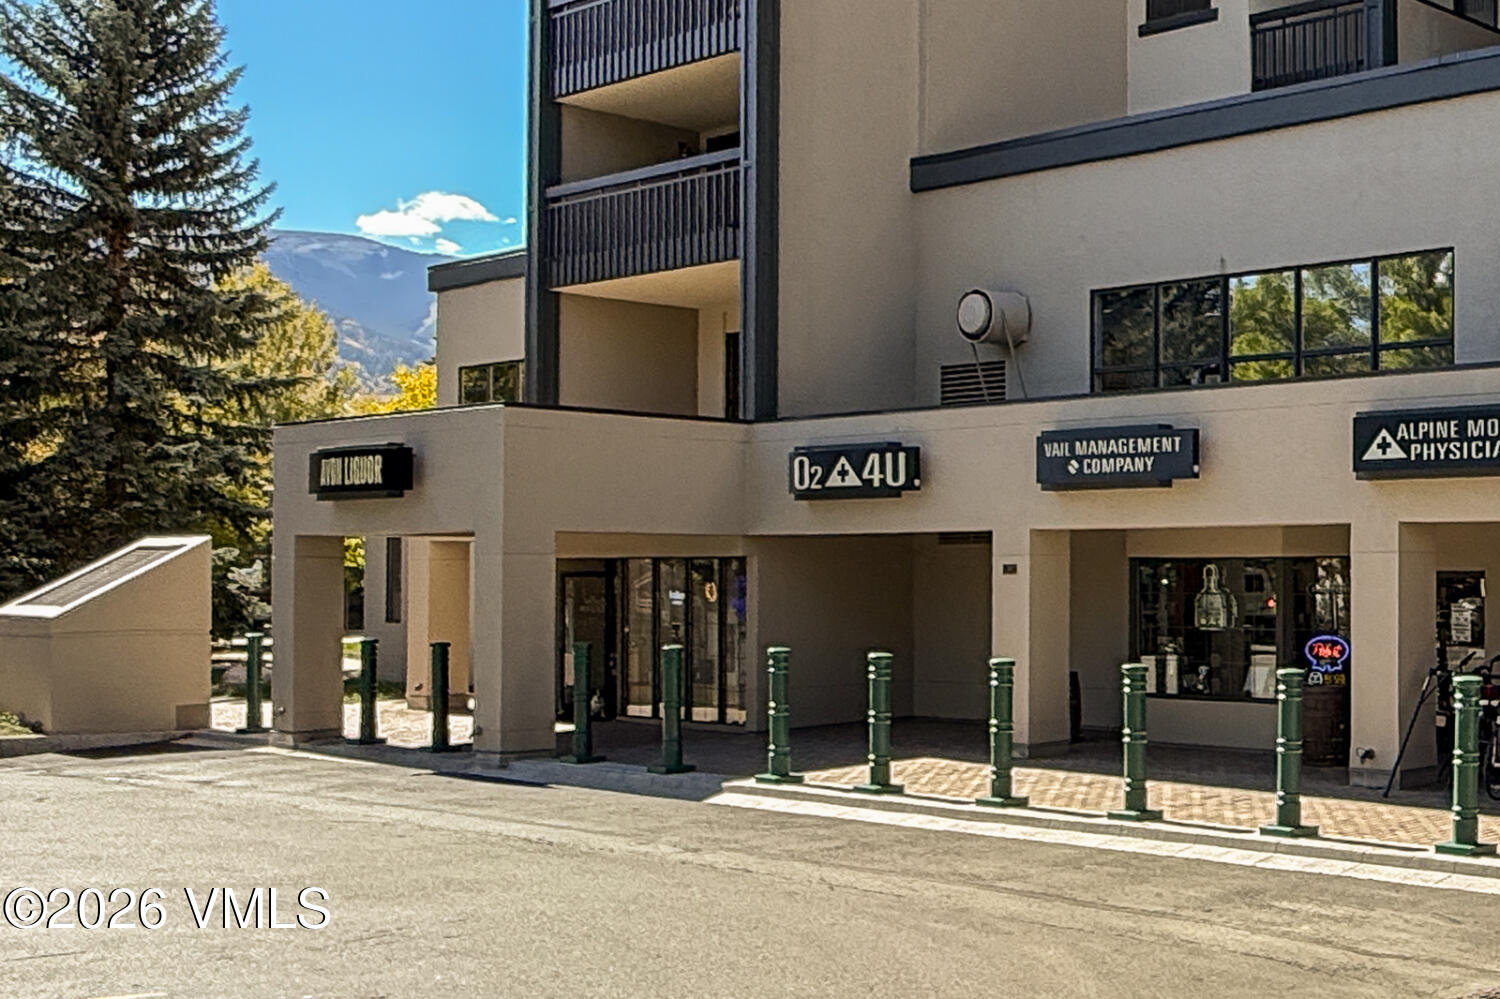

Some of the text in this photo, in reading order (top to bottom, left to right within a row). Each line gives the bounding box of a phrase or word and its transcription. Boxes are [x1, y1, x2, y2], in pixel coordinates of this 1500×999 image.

[1396, 420, 1460, 441] ALPINE
[1043, 436, 1182, 458] VAIL MANAGEMENT
[344, 454, 383, 486] LIQUOR
[862, 451, 907, 488] 4U
[1083, 456, 1155, 475] COMPANY
